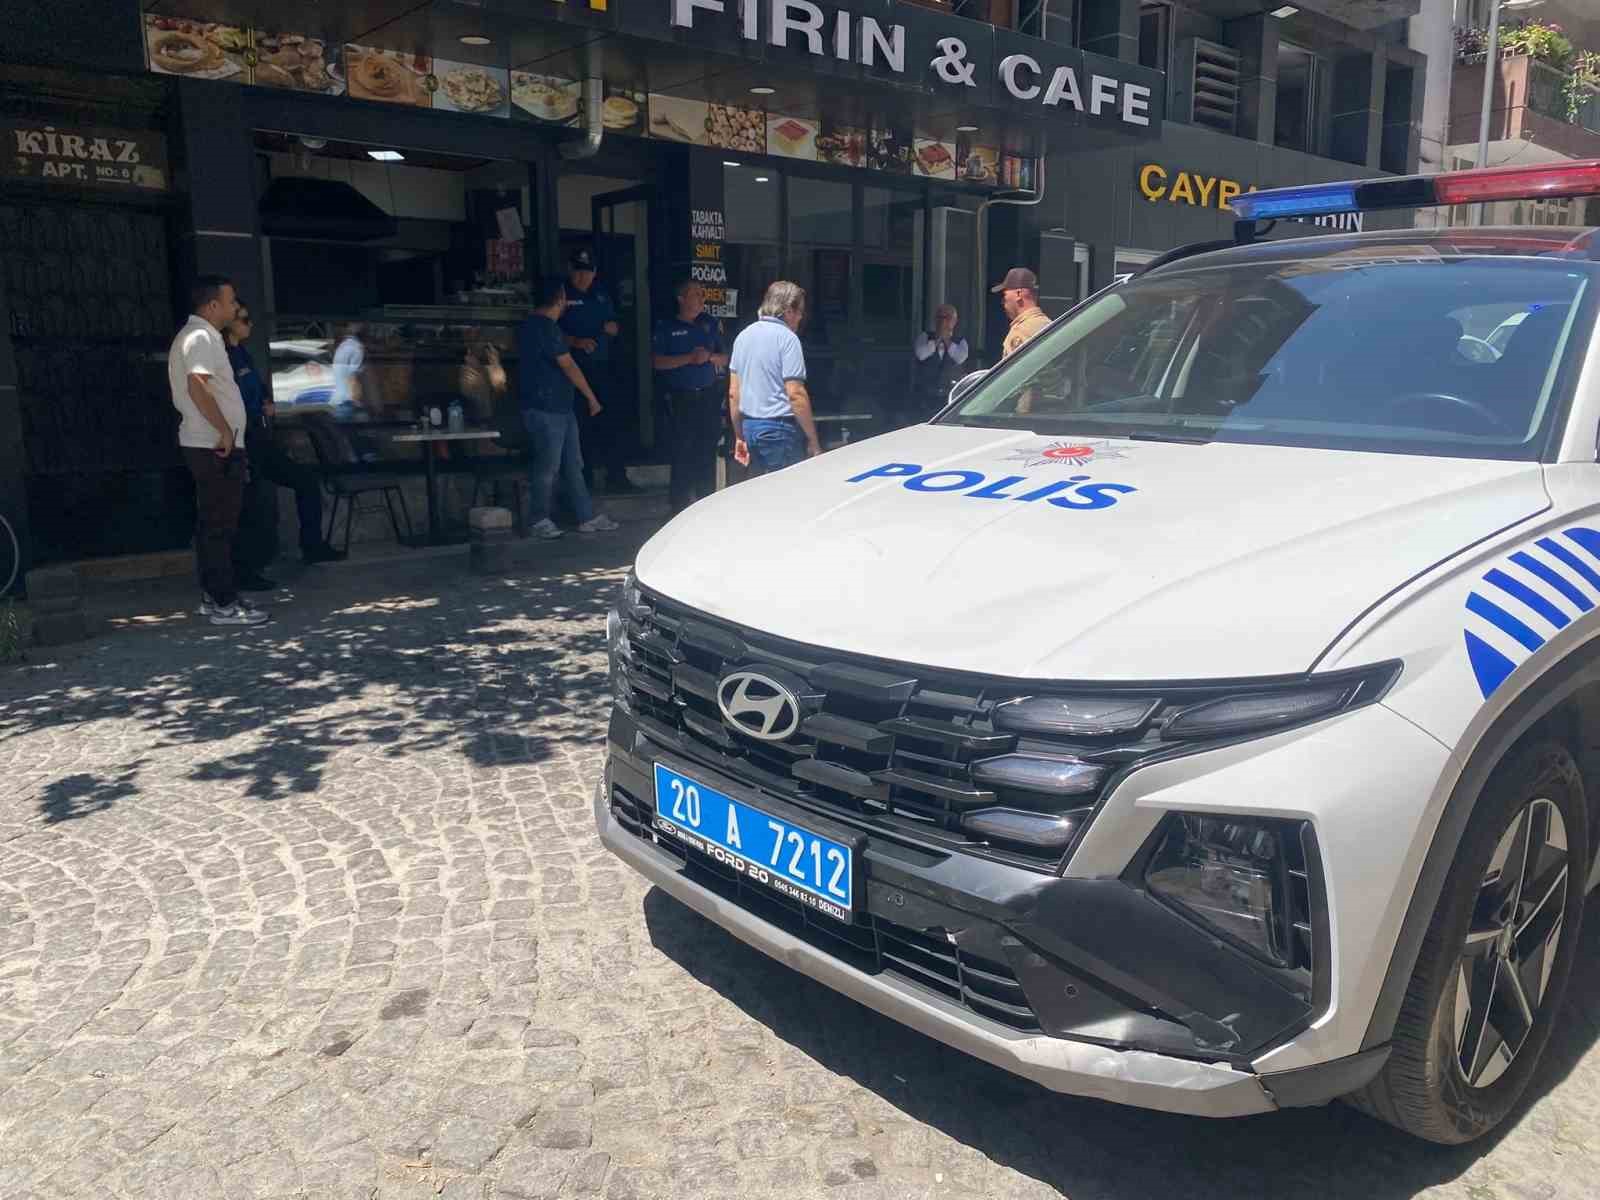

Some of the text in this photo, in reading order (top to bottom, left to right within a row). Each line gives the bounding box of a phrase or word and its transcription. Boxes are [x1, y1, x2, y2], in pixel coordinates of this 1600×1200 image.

[930, 36, 977, 87] &
[999, 54, 1151, 126] CAFE
[14, 126, 140, 164] KİRAZ
[42, 161, 88, 181] APT.
[1139, 164, 1258, 213] ÇAYB
[844, 462, 1139, 510] POLİS
[671, 779, 700, 828] 20
[726, 803, 742, 849] A
[768, 820, 846, 898] 7212
[706, 843, 746, 872] FORD
[748, 865, 769, 884] 20
